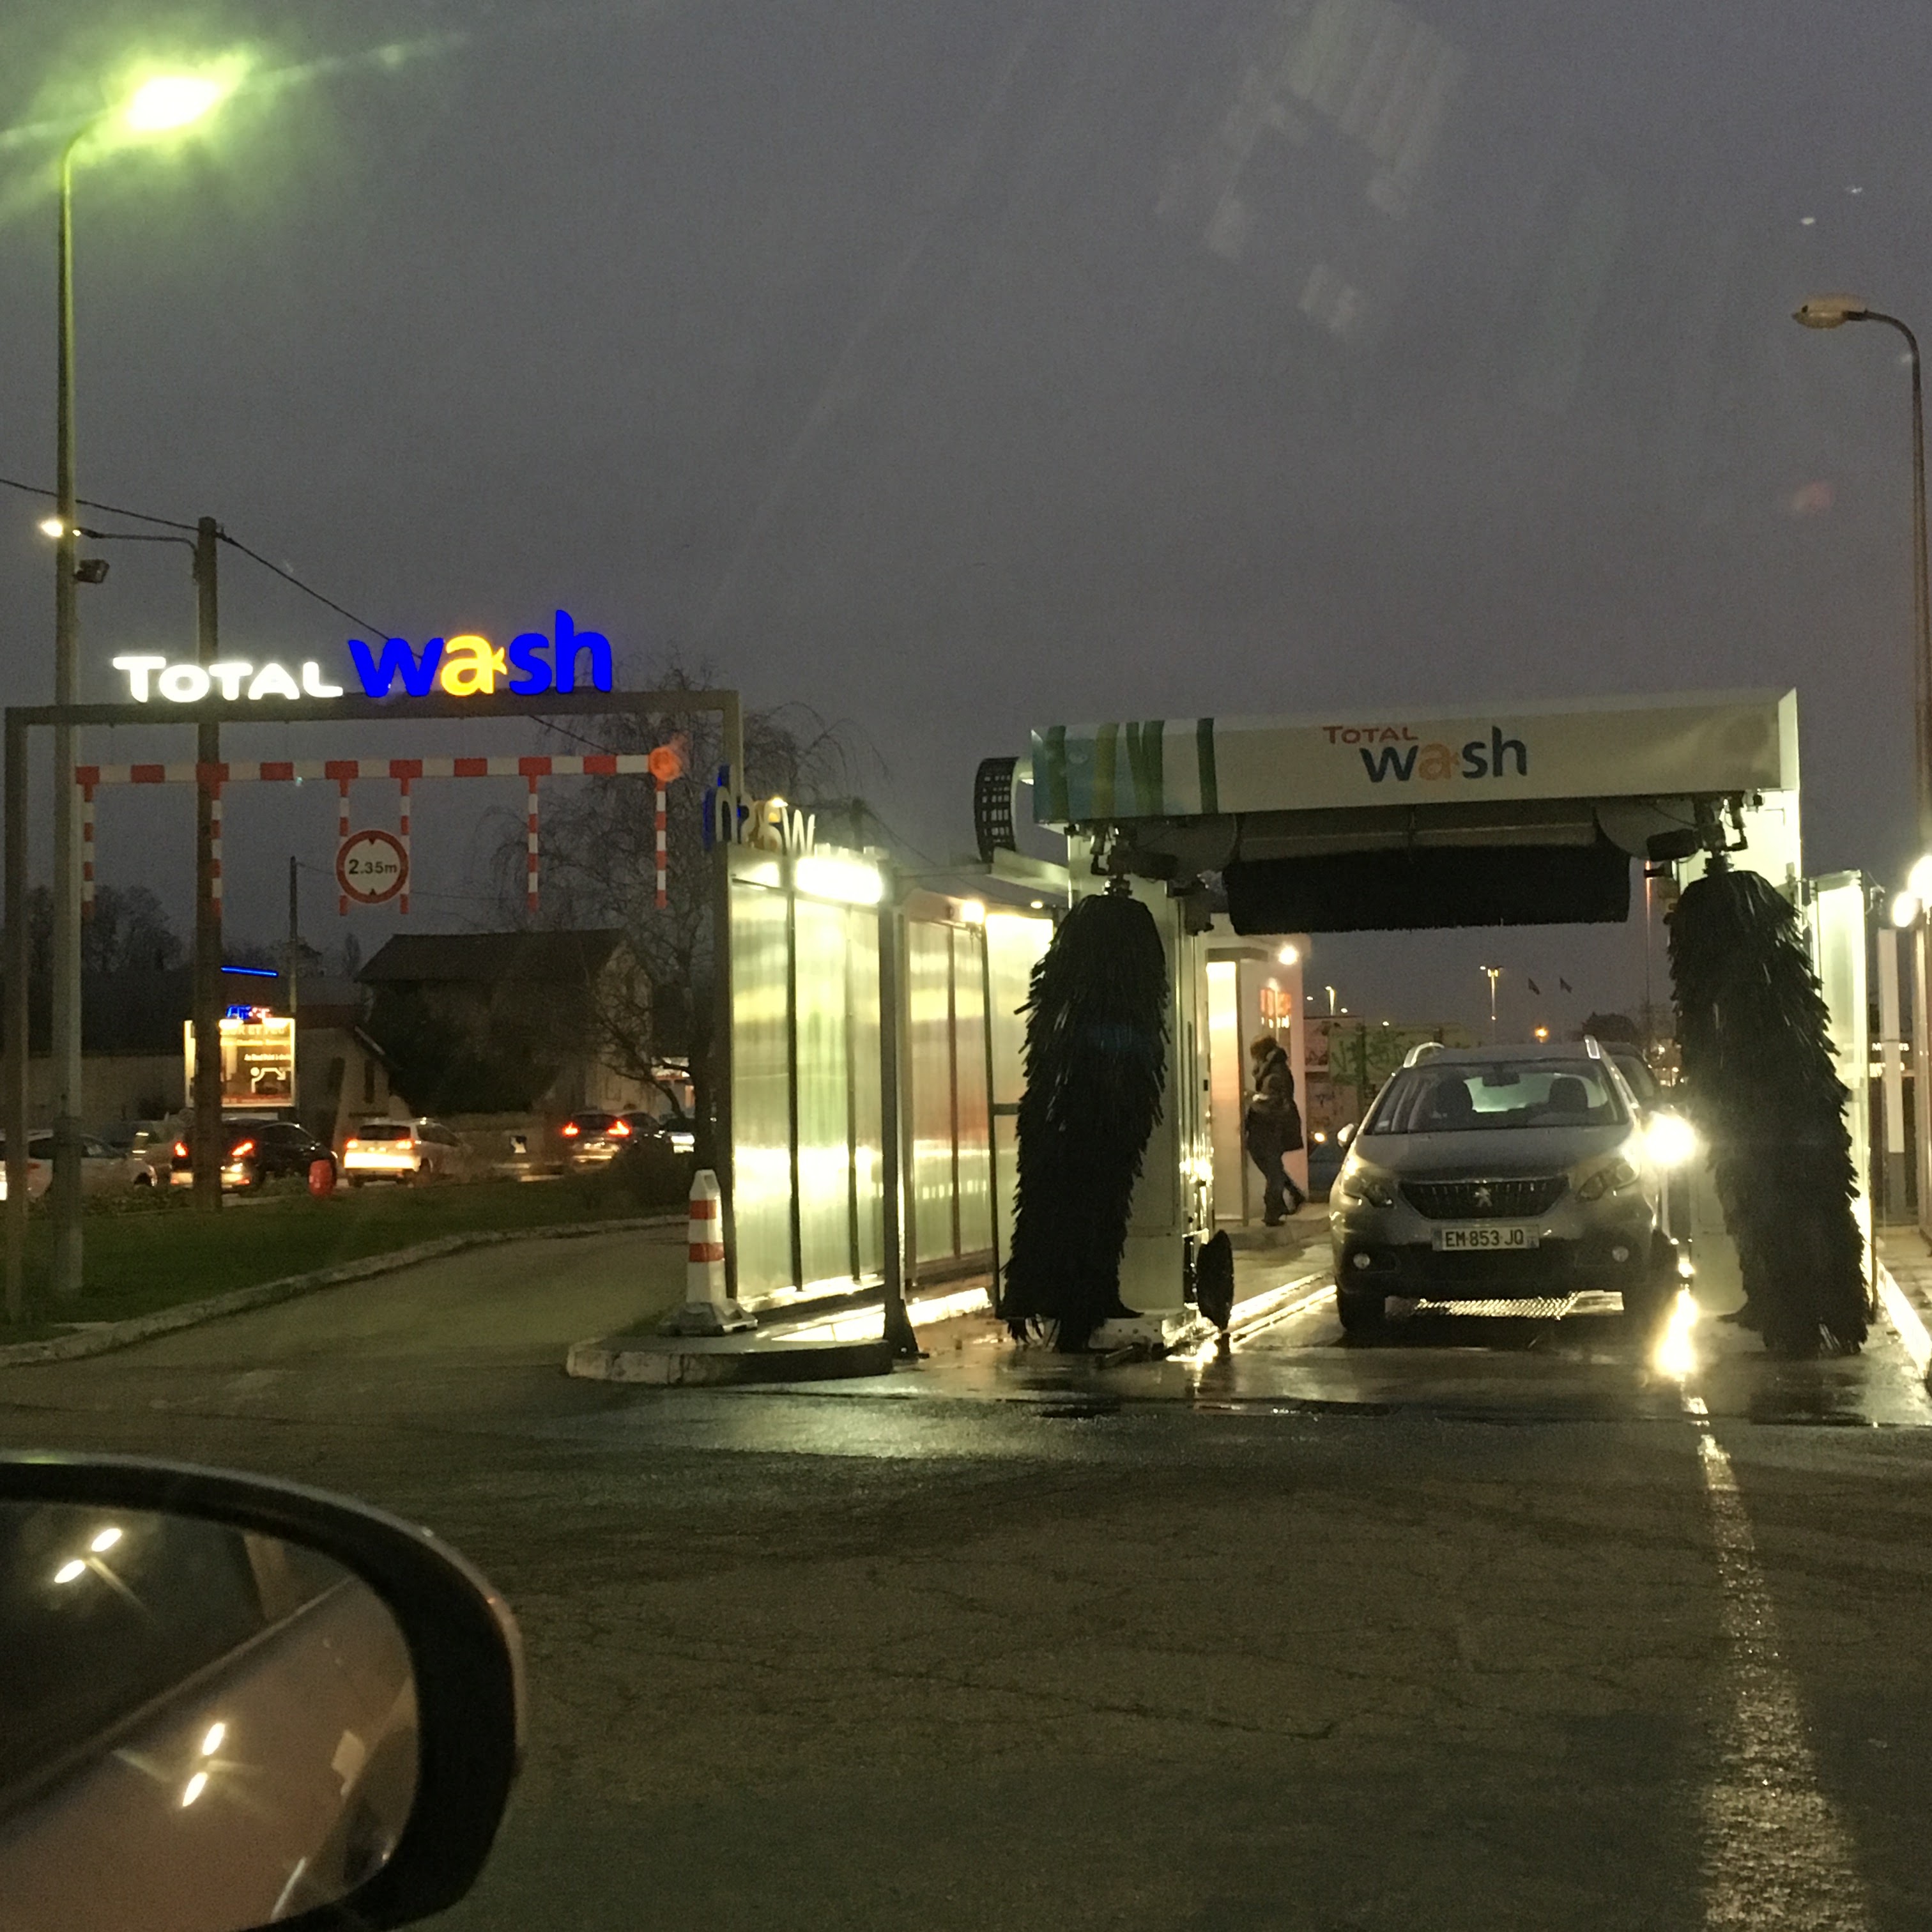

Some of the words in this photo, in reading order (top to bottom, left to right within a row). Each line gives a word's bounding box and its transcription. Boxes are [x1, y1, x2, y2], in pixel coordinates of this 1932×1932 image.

[112, 656, 344, 703] TOTAL
[348, 610, 613, 698] wash
[1322, 724, 1419, 745] TOTAL
[1358, 725, 1528, 783] wash
[348, 859, 397, 875] 2.35m
